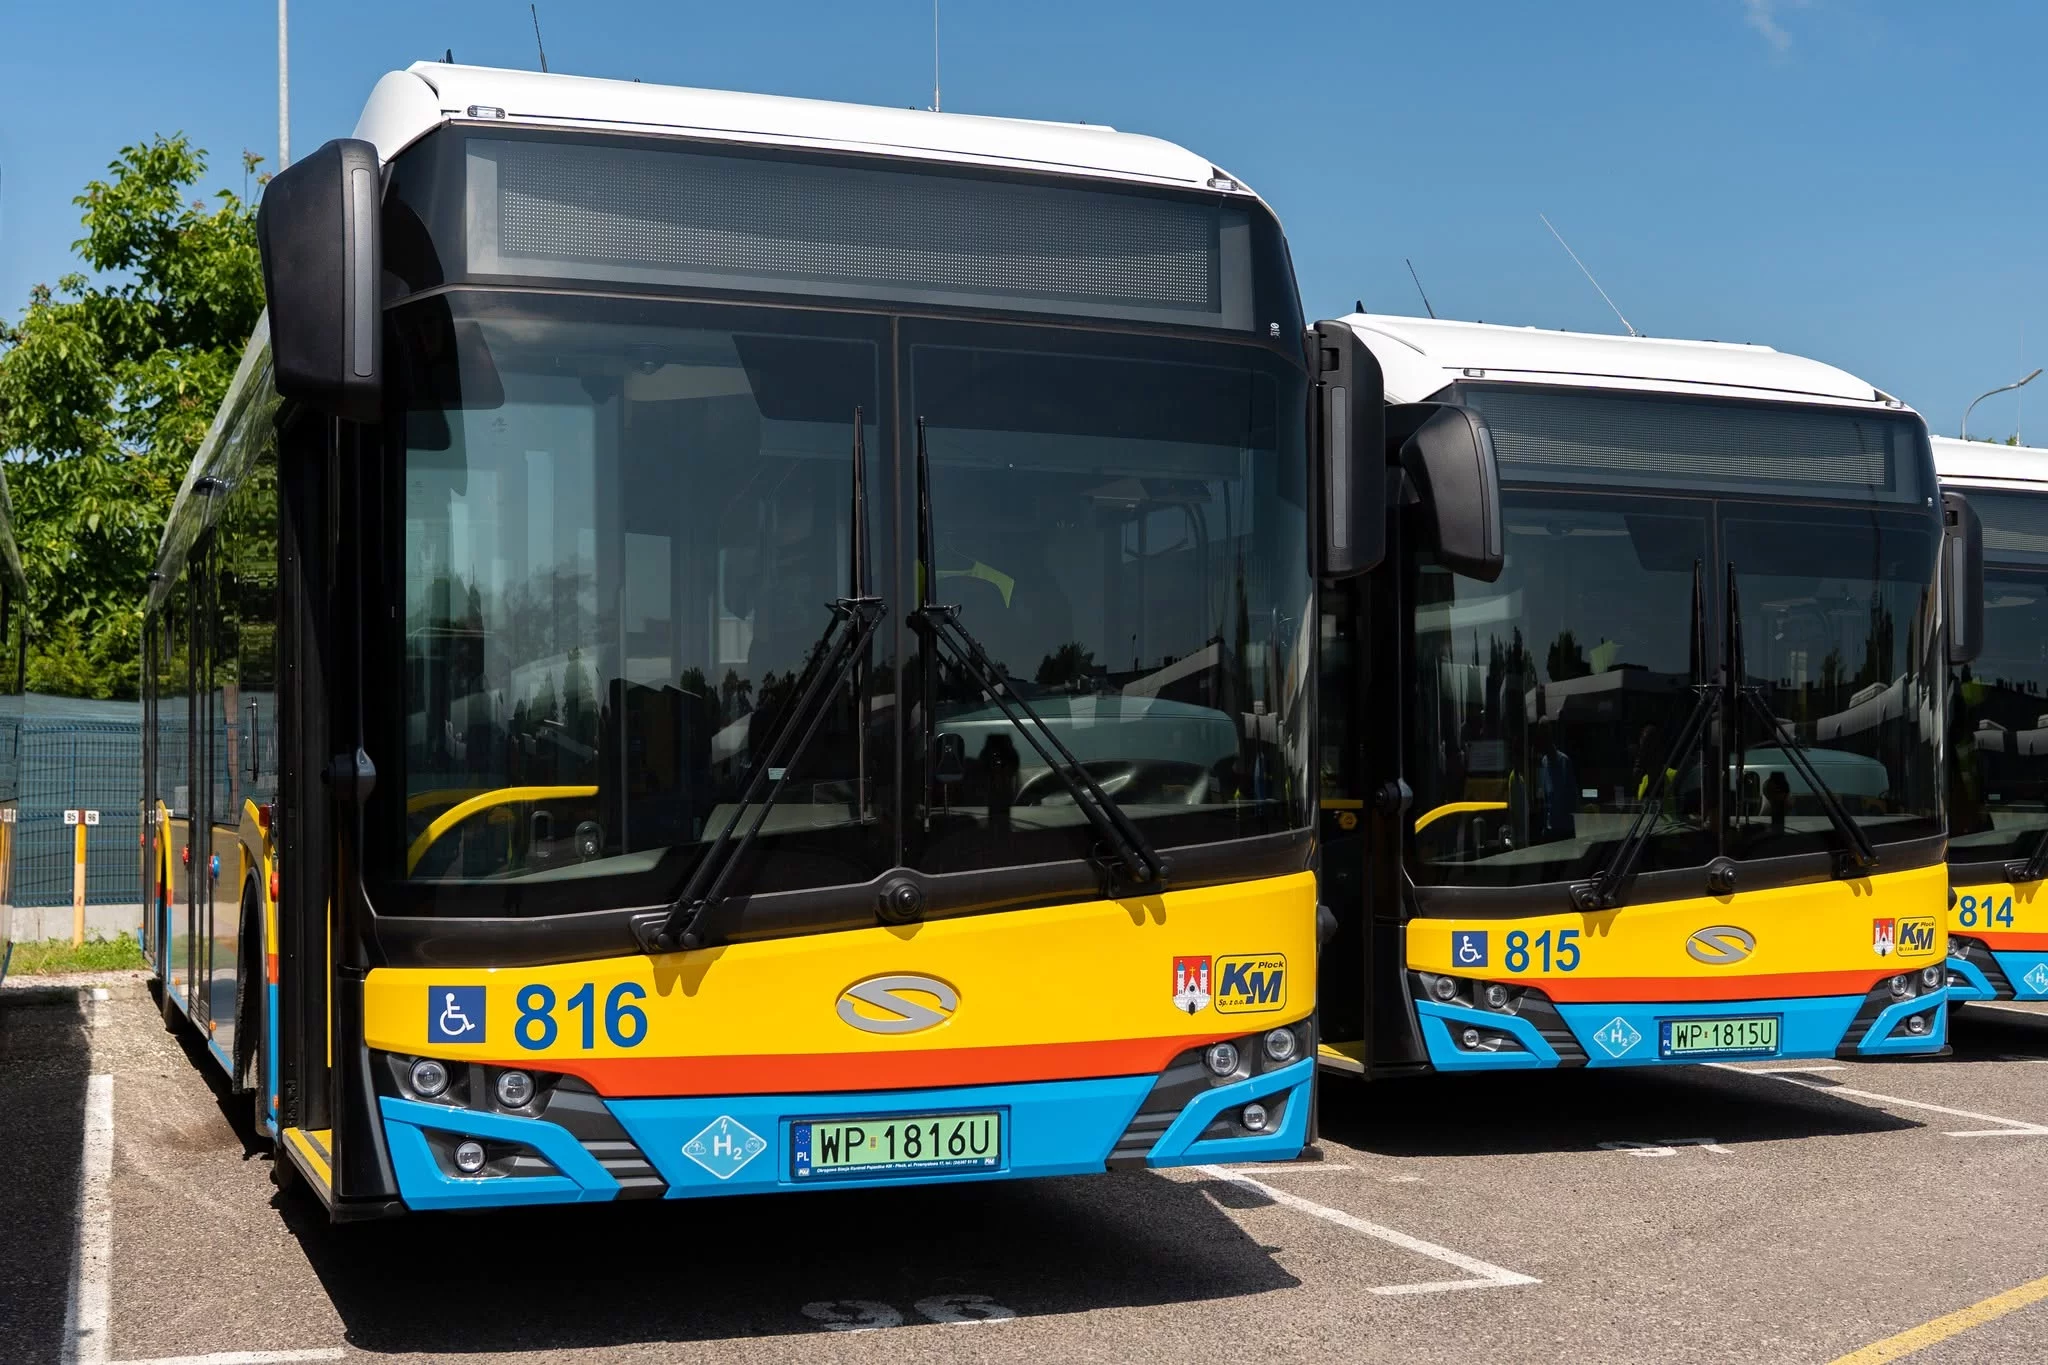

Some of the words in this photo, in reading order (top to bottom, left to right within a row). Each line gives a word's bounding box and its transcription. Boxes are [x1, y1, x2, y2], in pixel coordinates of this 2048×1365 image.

[1959, 896, 2014, 928] 814
[1505, 930, 1581, 973] 815
[1899, 922, 1934, 950] KM
[1258, 961, 1284, 969] Płock
[1219, 962, 1284, 1004] KM
[514, 981, 649, 1051] 816
[1677, 1025, 1702, 1048] WP
[1712, 1022, 1772, 1046] 1815U
[797, 1151, 809, 1161] PL
[820, 1127, 865, 1163] WP
[884, 1120, 989, 1159] 1816U
